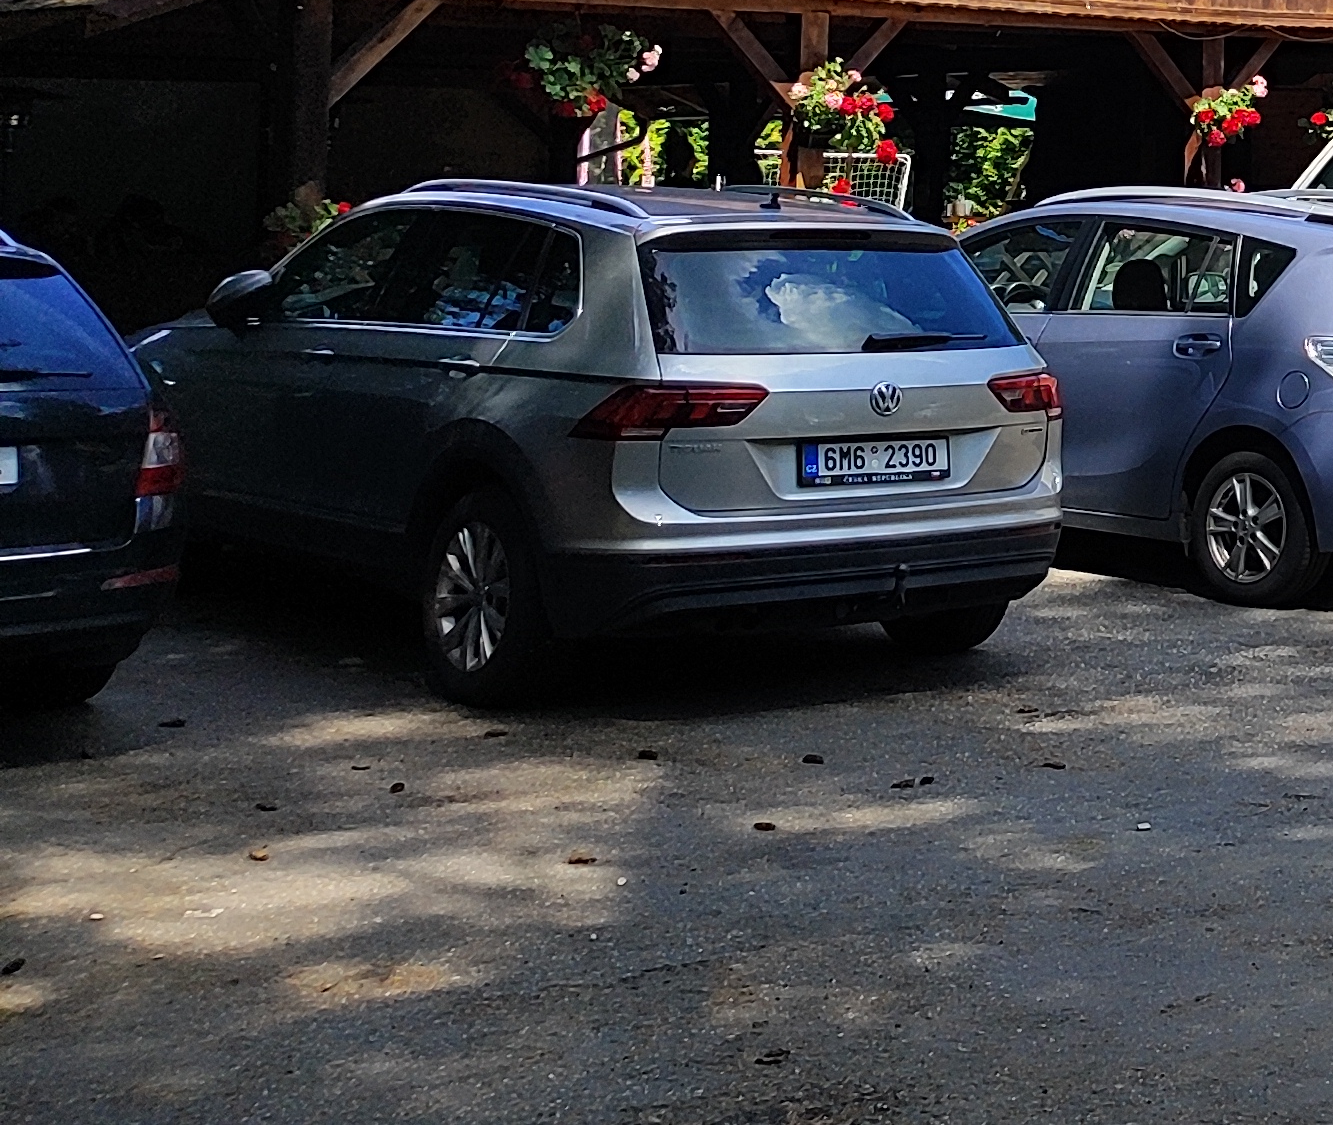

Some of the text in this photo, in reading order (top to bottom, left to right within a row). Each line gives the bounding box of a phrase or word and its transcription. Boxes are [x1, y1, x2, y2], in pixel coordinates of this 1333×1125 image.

[824, 443, 937, 471] 6M6 2390
[806, 465, 817, 473] CZ
